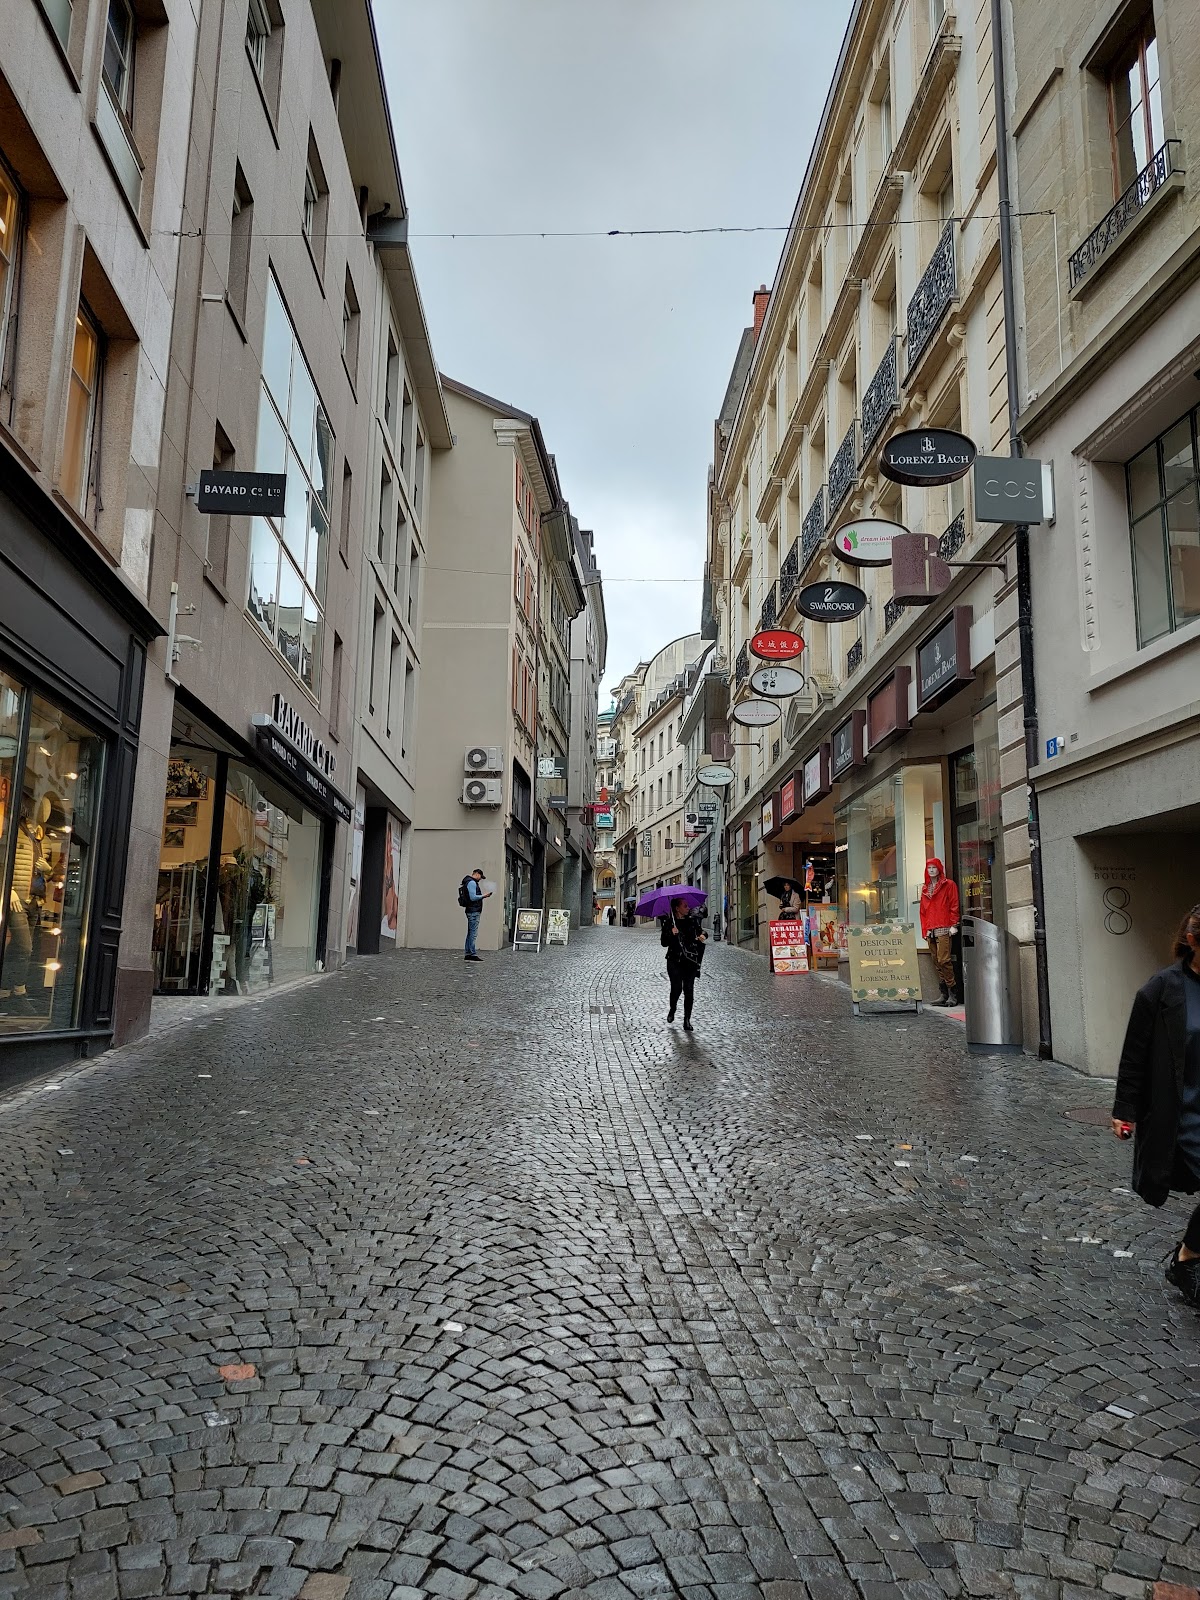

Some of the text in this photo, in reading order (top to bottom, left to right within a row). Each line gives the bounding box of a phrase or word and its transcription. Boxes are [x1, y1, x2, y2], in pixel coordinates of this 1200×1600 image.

[890, 454, 969, 464] LORENZ BACH
[204, 485, 247, 495] BAYARD
[984, 479, 1037, 499] COS
[810, 602, 855, 611] SWAROVSKI
[922, 653, 957, 693] LORENZ BACH
[273, 694, 315, 759] BAYARD
[1050, 741, 1054, 754] 8
[1103, 887, 1132, 935] 8
[860, 939, 903, 947] DESIGNER
